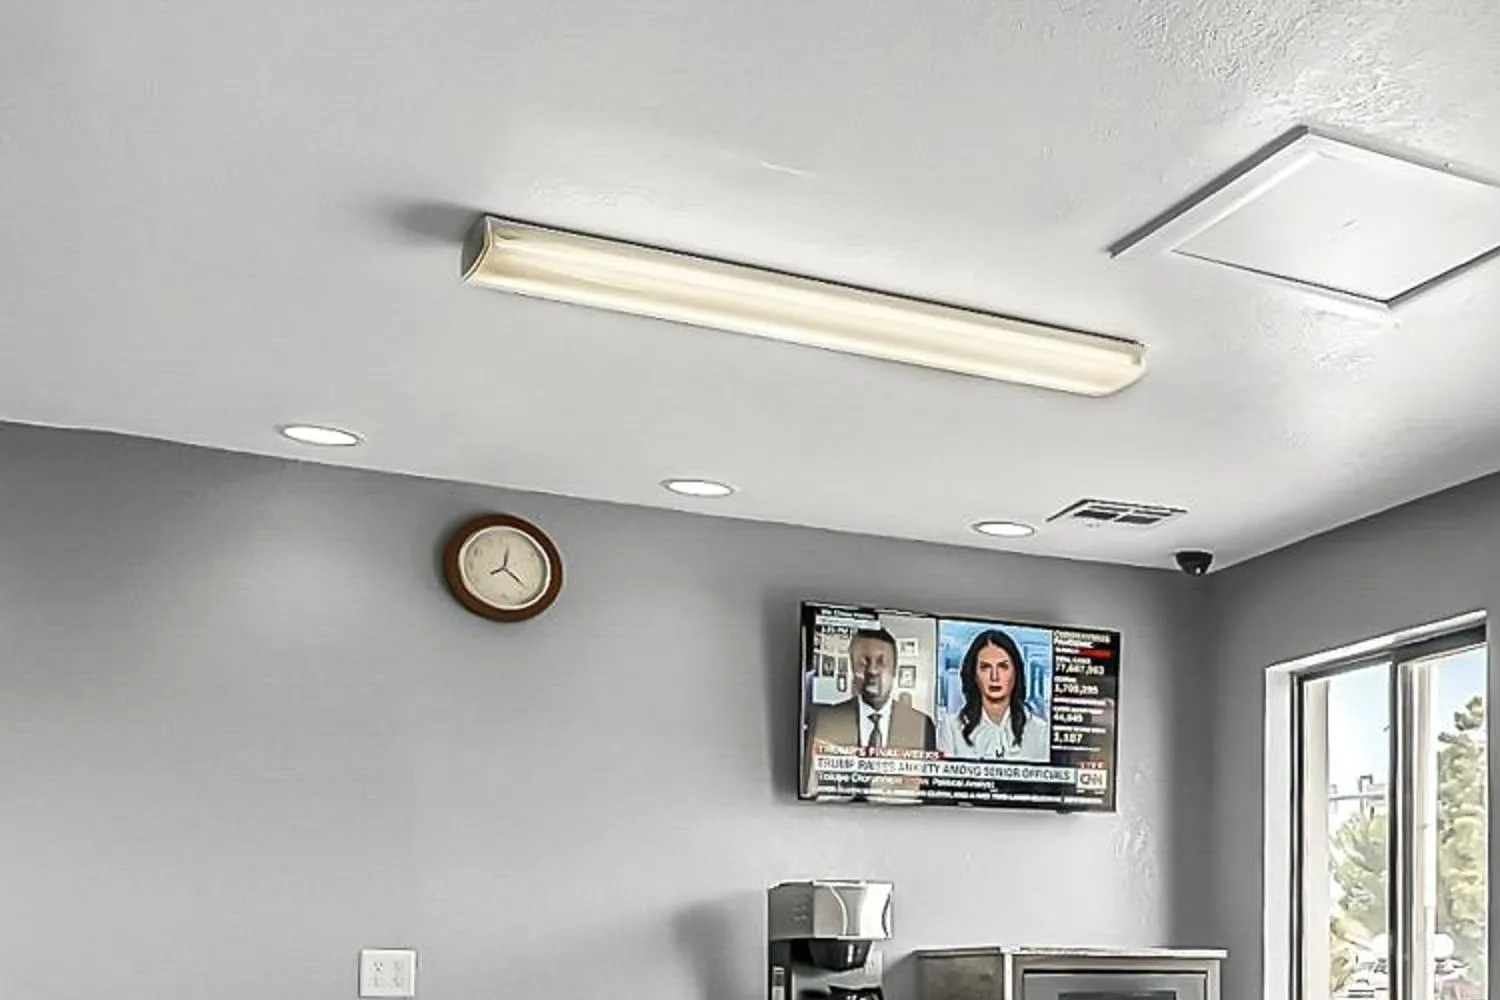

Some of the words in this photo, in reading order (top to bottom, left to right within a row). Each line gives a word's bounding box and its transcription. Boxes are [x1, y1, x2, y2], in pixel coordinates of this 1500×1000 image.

[817, 758, 855, 770] TRUMP
[943, 764, 982, 776] AMONG
[984, 767, 1021, 779] SENIOR
[1021, 769, 1069, 781] OFFICIALS
